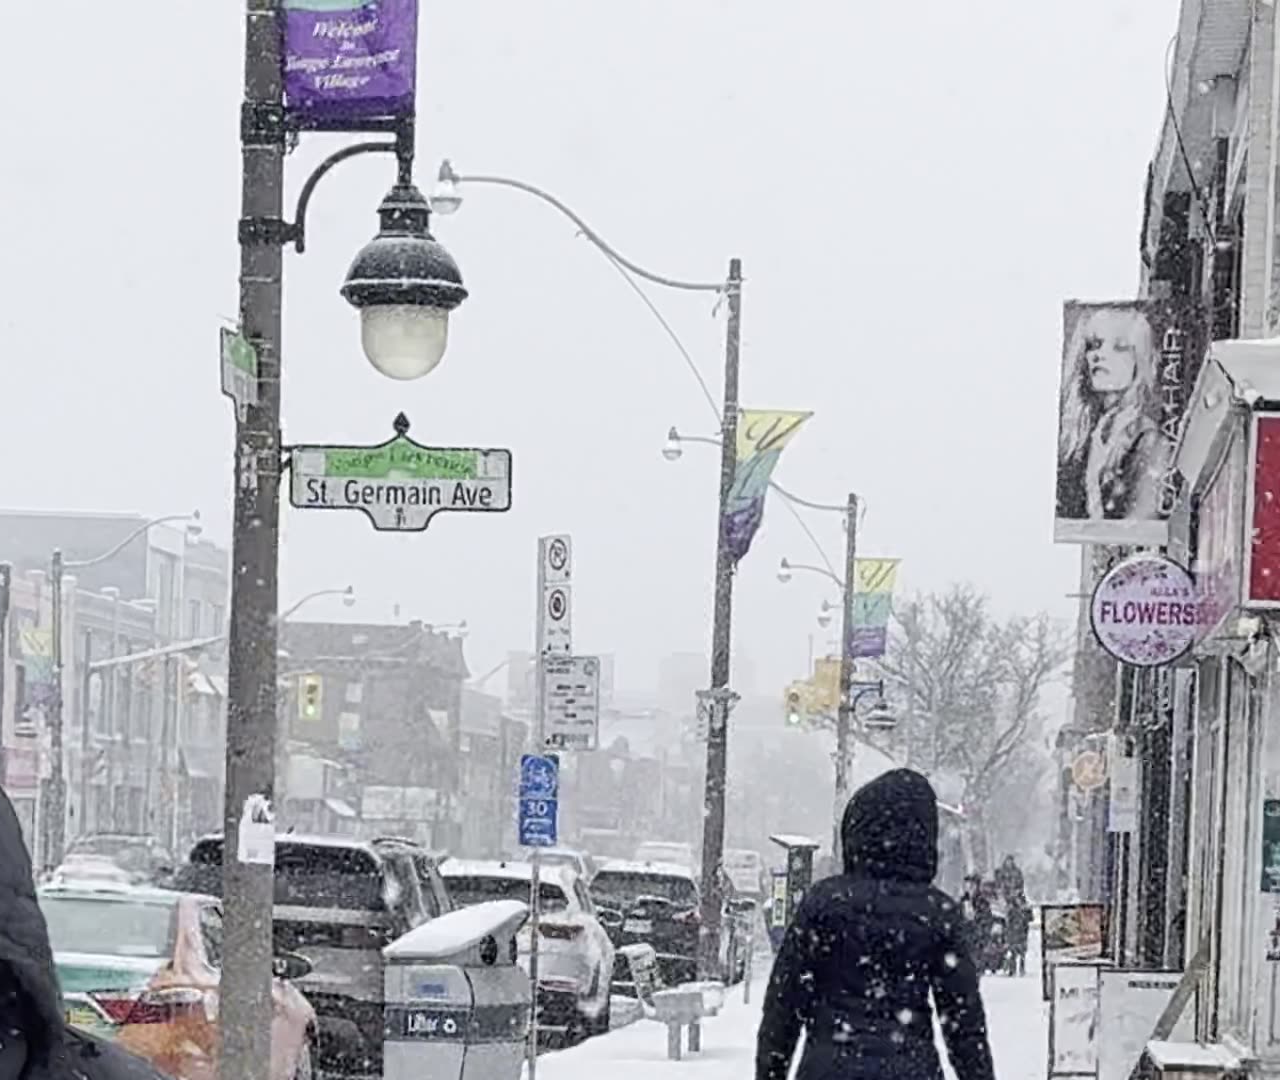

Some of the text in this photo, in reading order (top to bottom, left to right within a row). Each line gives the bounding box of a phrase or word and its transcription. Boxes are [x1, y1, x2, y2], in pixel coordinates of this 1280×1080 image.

[344, 479, 442, 505] Germain
[451, 482, 493, 506] Ave
[1100, 601, 1195, 625] FLOWERS
[527, 801, 549, 817] 30
